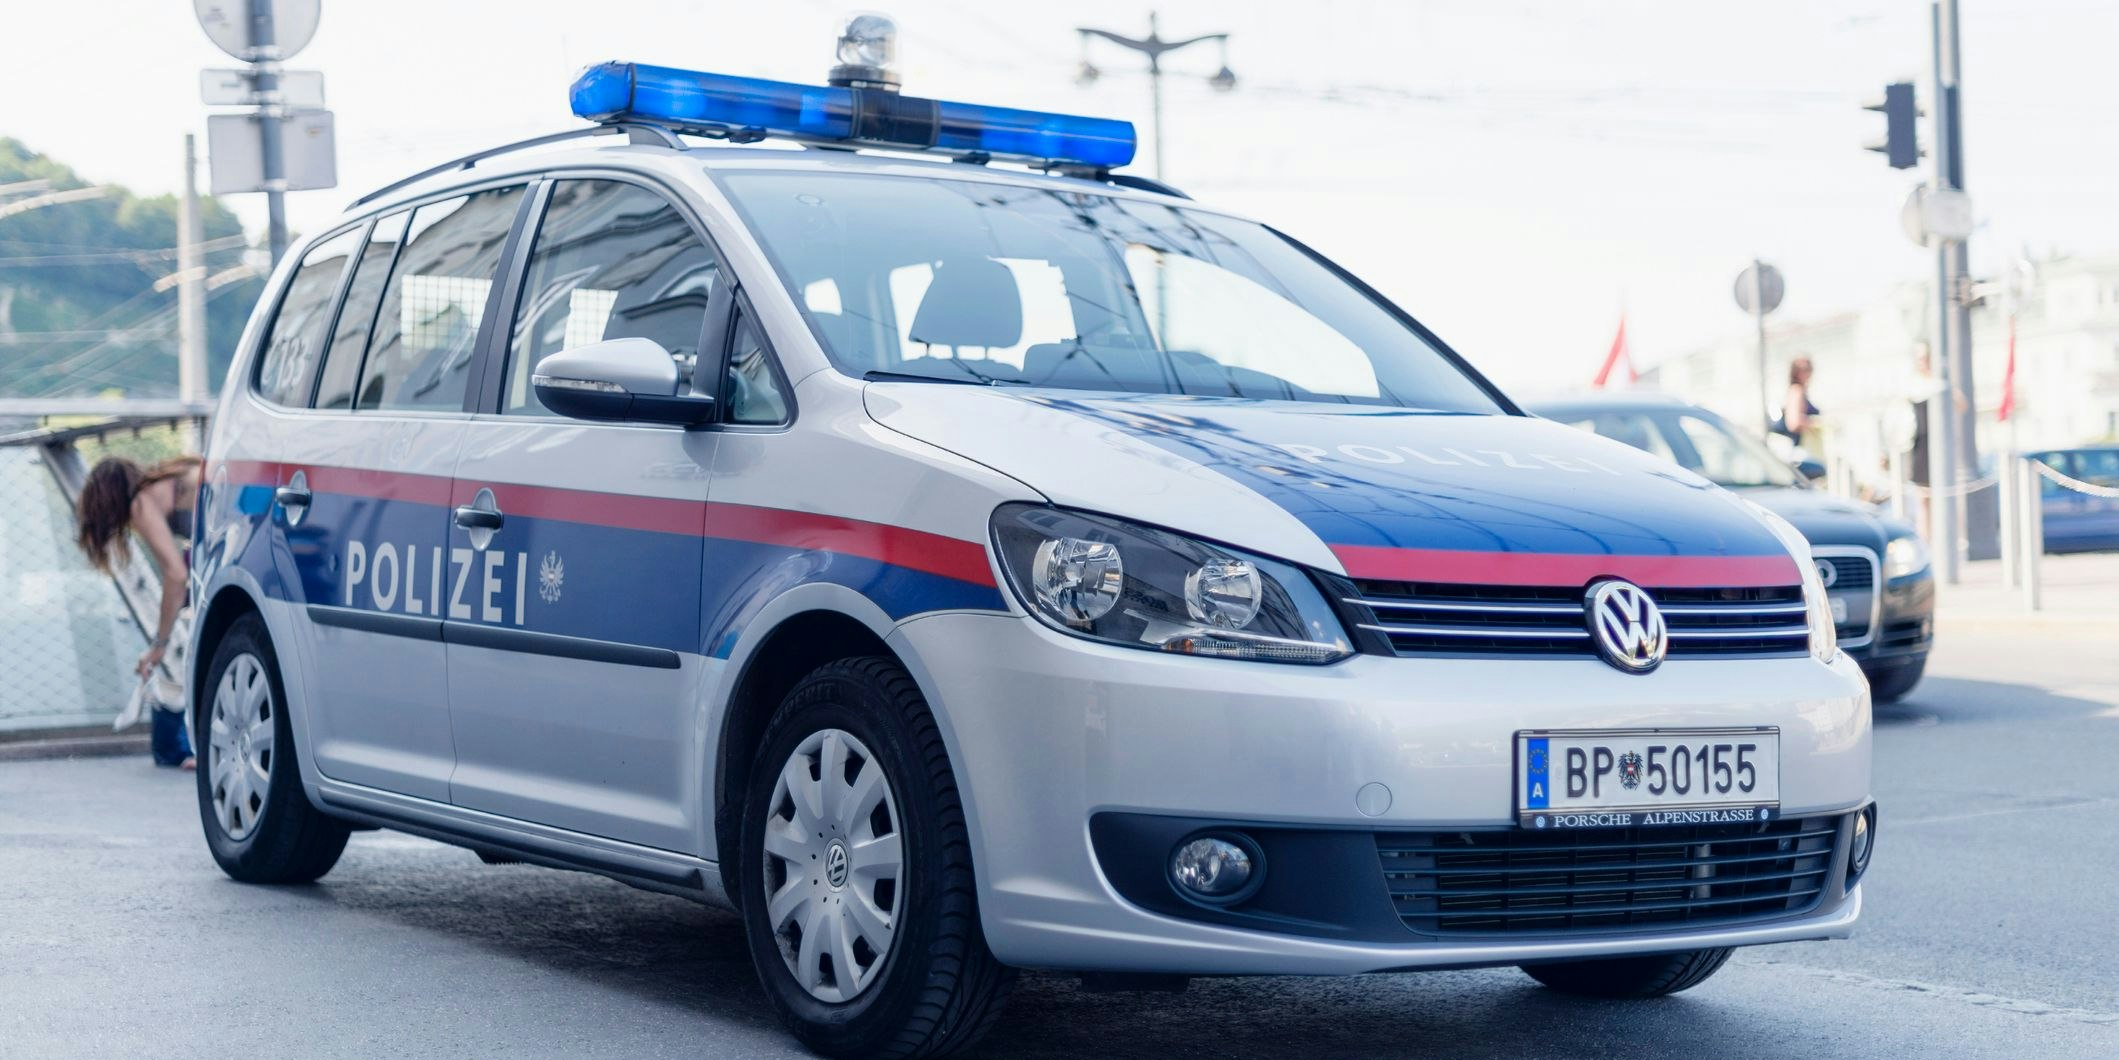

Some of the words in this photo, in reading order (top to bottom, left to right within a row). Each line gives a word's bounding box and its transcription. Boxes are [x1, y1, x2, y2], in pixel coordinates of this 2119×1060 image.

[1276, 443, 1622, 476] POLIZEI
[345, 540, 527, 625] POLIZEI
[1594, 581, 1667, 667] VW
[1532, 782, 1544, 798] A
[1566, 746, 1614, 798] BP
[1647, 744, 1756, 795] 50155
[1553, 813, 1631, 828] PORSCHE
[1642, 809, 1754, 825] ALPENSTRASSE
